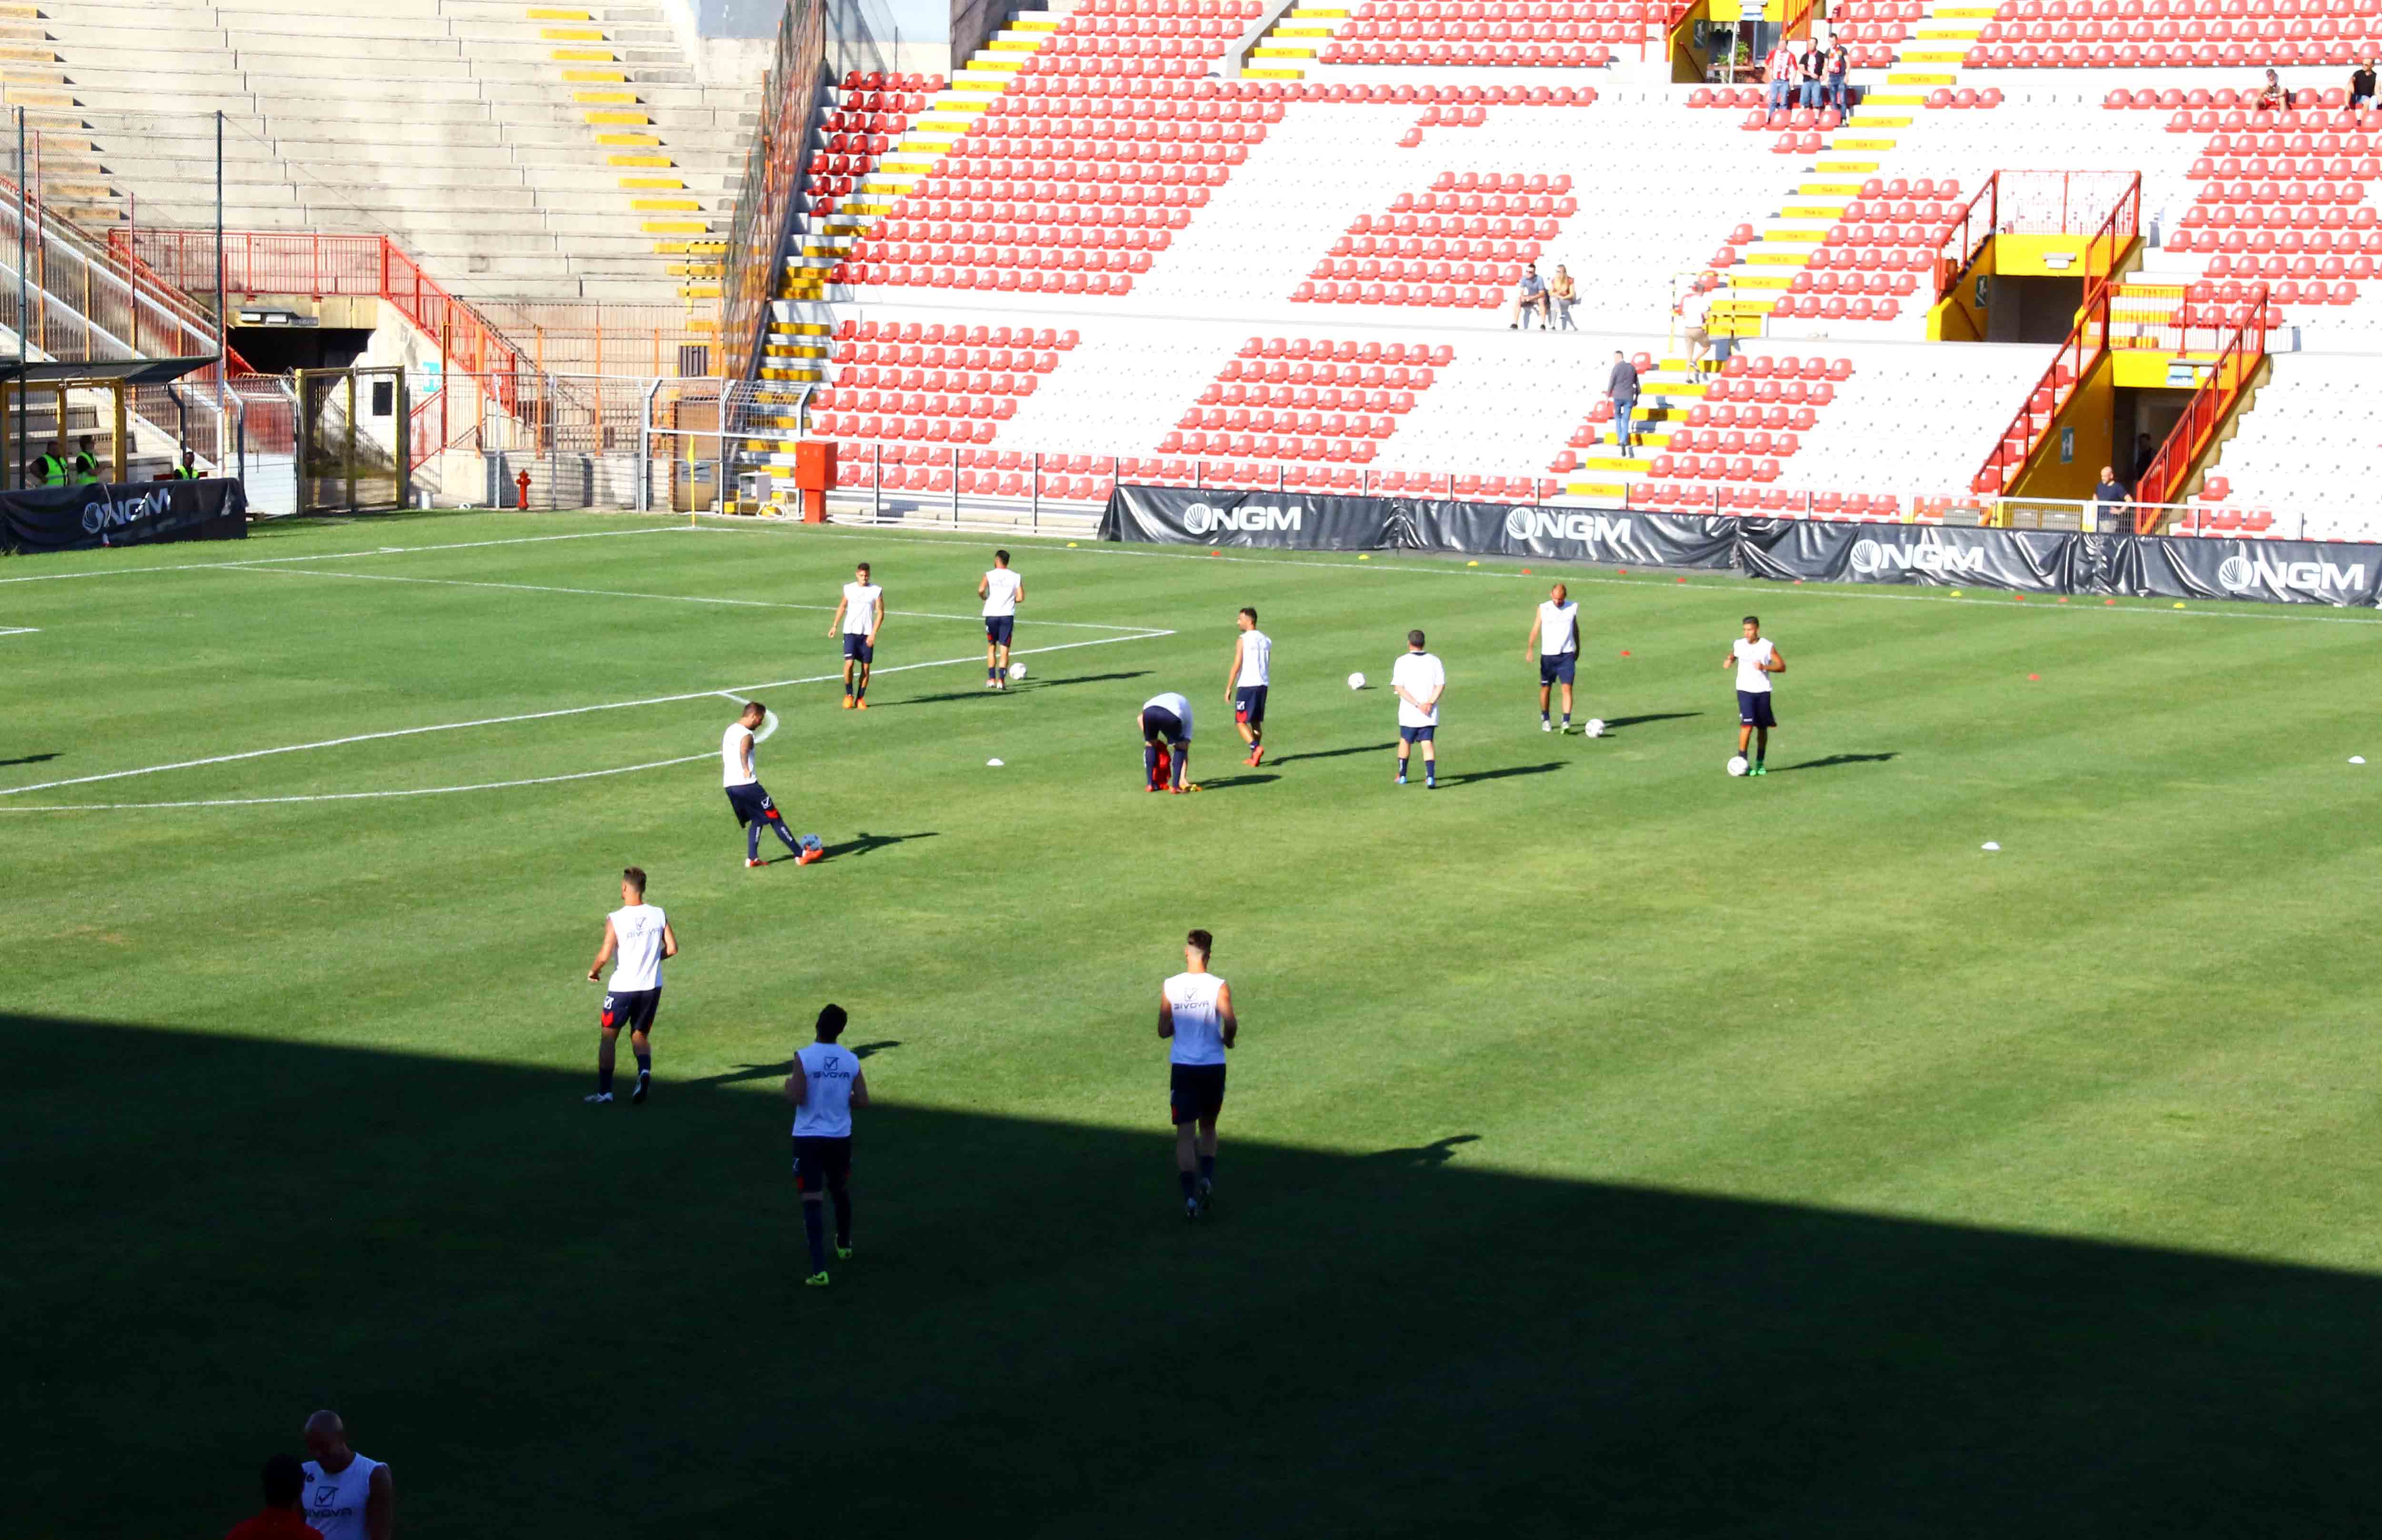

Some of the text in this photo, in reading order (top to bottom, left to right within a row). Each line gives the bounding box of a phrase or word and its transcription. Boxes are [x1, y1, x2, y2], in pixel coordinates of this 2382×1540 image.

[1210, 506, 1301, 531] NGM
[1534, 512, 1632, 544] NGM
[1880, 543, 1984, 572] NGM
[2251, 561, 2365, 590] NGM
